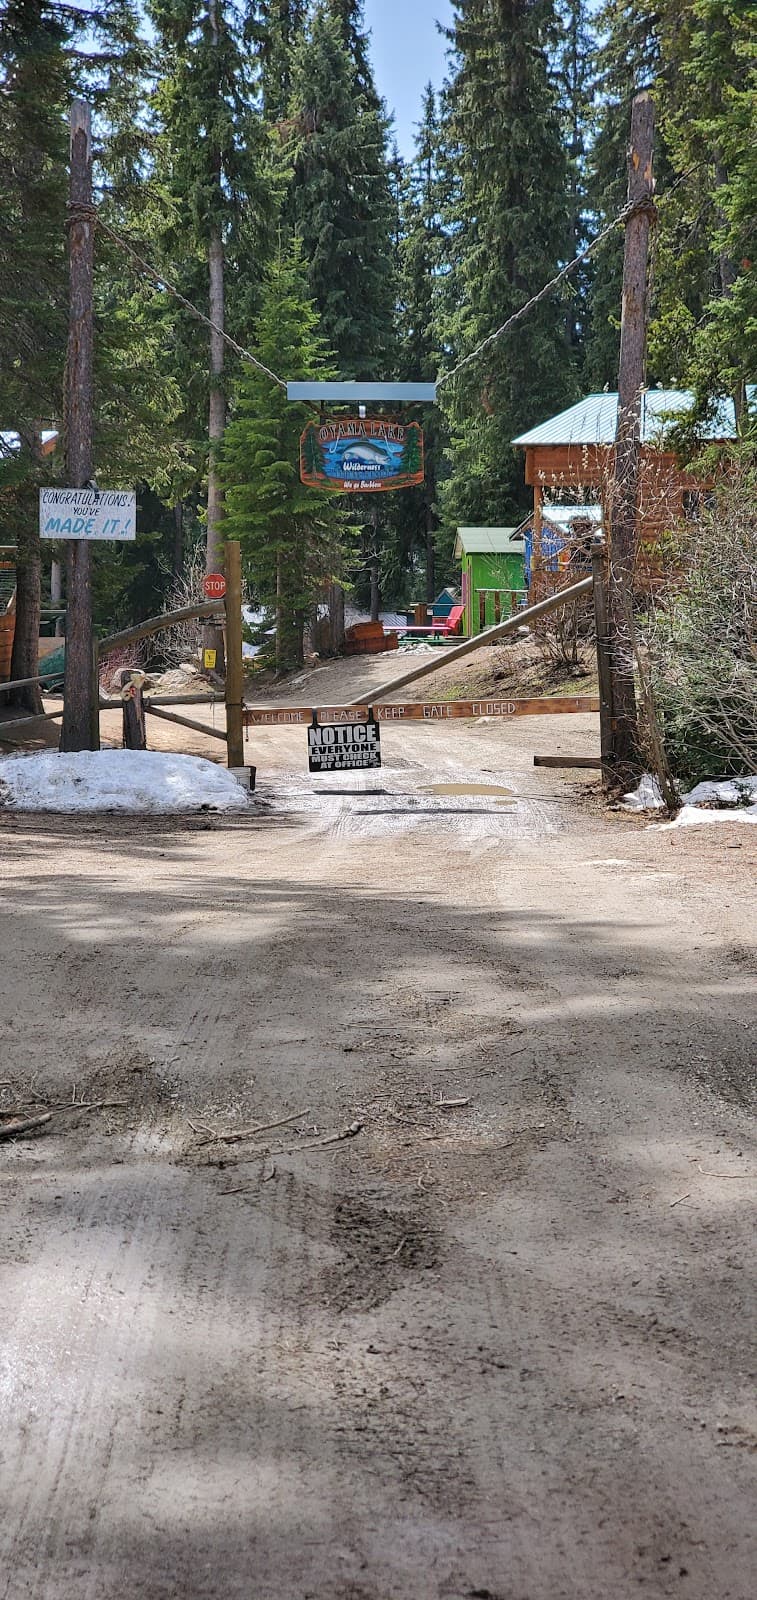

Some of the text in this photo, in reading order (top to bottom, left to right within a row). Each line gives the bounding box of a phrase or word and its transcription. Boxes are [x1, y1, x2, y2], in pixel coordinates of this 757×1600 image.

[319, 421, 405, 442] OYAMA LAKE
[343, 461, 381, 472] Wilderness
[42, 491, 135, 507] CONGRATULATIONS!
[44, 518, 96, 533] MADE
[205, 581, 226, 591] STOP
[251, 702, 516, 723] WELCOME PLEASE KEEP GATE CLOSED
[309, 725, 377, 746] NOTICE
[311, 743, 377, 755] EVERYONE
[311, 752, 377, 763] MUST CHECK
[335, 759, 369, 768] OFFICE
